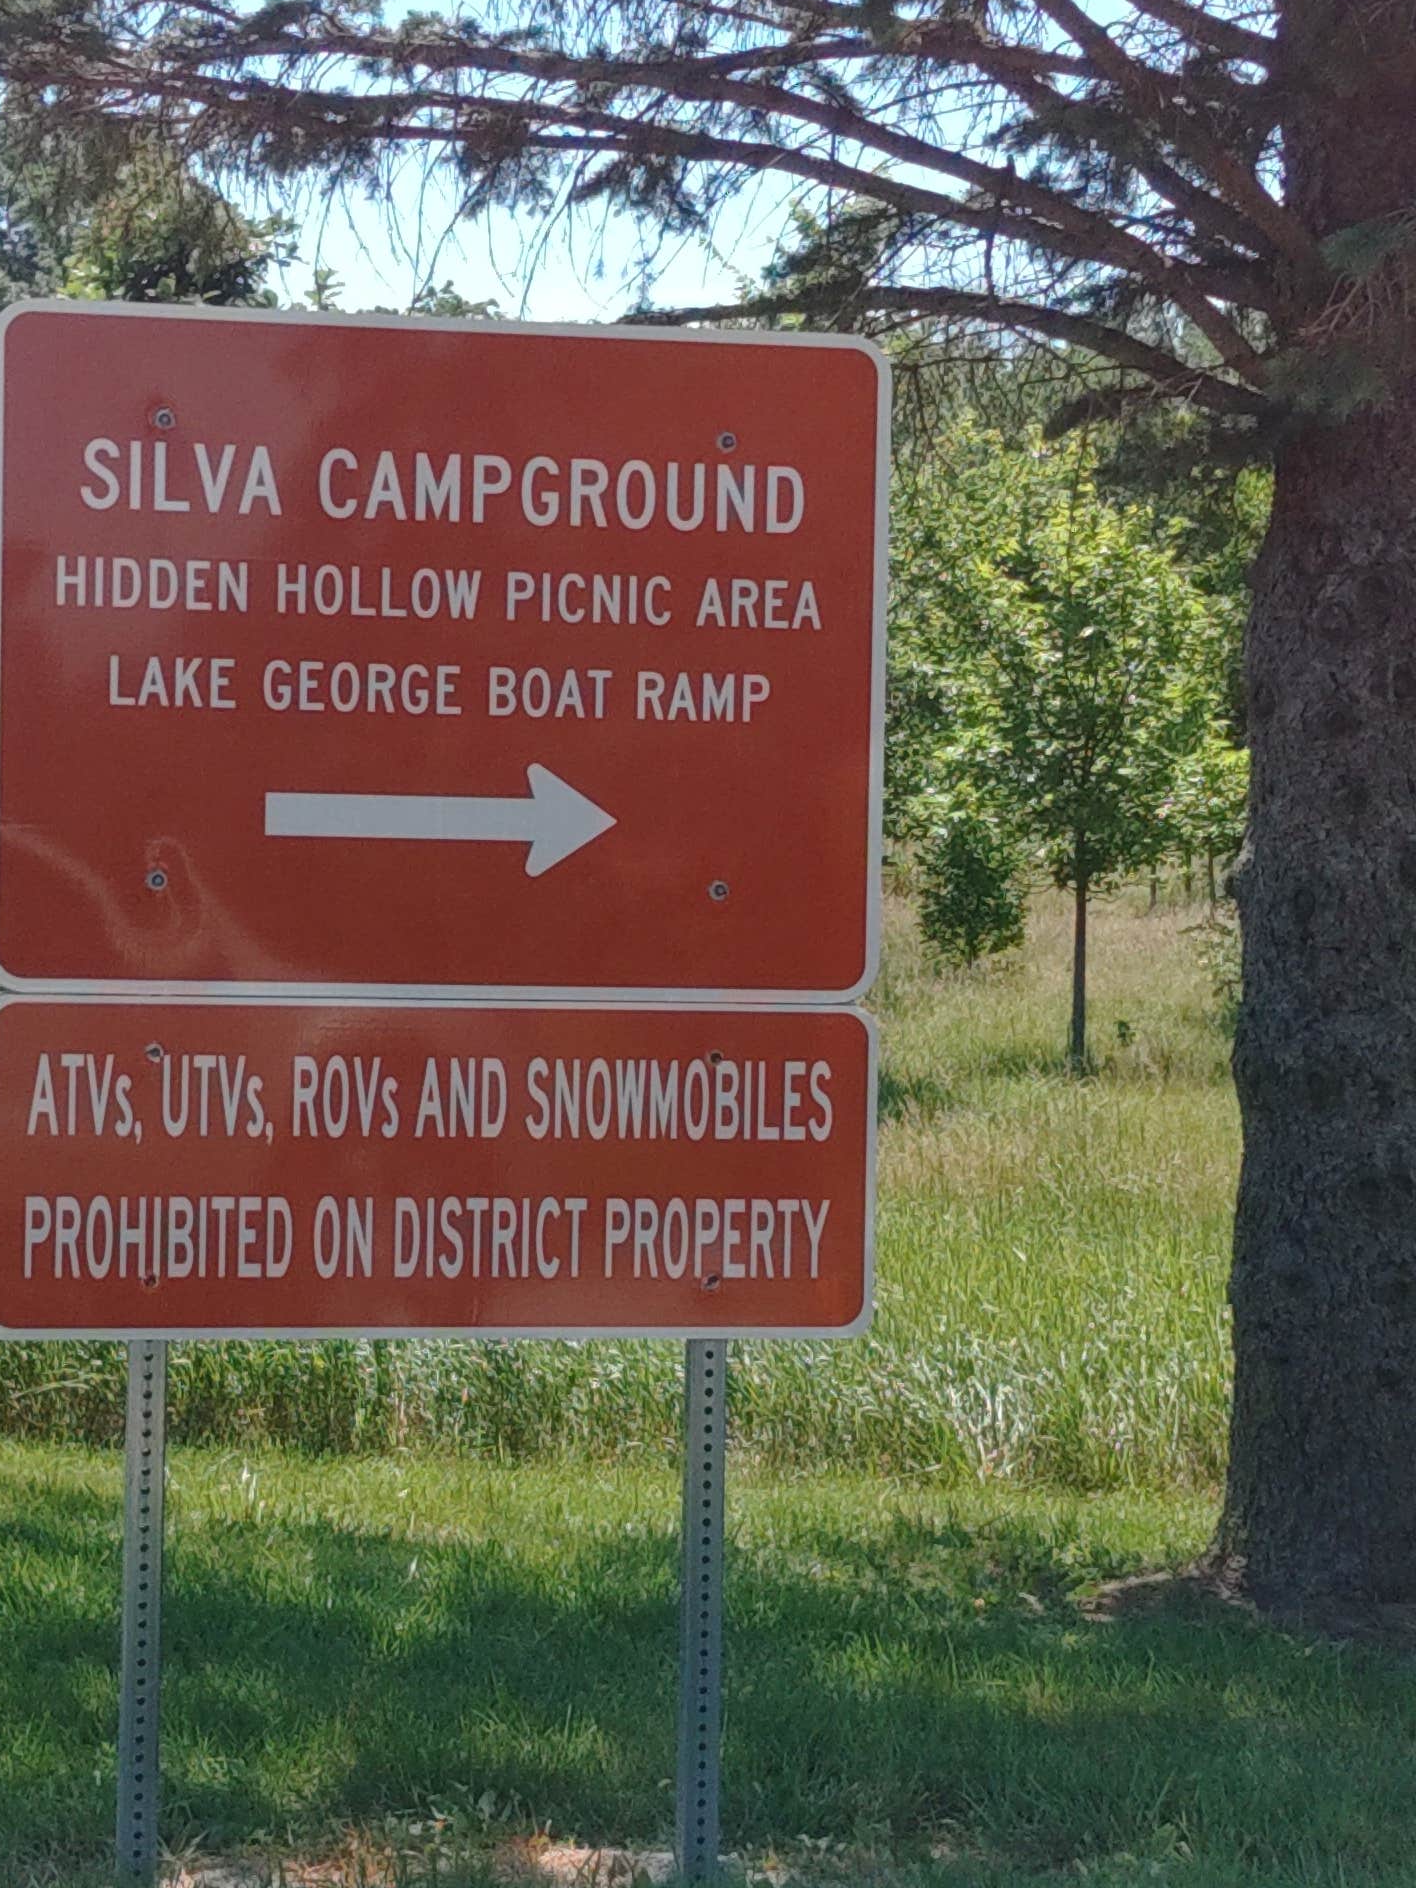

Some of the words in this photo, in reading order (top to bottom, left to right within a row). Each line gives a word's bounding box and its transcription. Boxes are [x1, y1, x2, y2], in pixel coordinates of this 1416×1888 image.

[80, 437, 282, 516] SILVA
[319, 448, 804, 534] CAMPGROUND
[56, 555, 248, 612] HIDDEN
[277, 563, 482, 619] HOLLOW
[507, 571, 671, 626] PICNIC
[696, 578, 821, 630] AREA
[109, 655, 236, 709] LAKE
[263, 660, 462, 715] GEORGE
[489, 667, 613, 719] BOAT
[637, 671, 770, 722] RAMP
[27, 1053, 142, 1144] ATVs,
[162, 1054, 273, 1144] UTVs,
[293, 1055, 399, 1138] ROVs
[414, 1057, 507, 1138] AND
[525, 1057, 833, 1142] SNOWMOBILES
[24, 1195, 293, 1279] PROHIBITED
[313, 1196, 373, 1279] ON
[394, 1196, 587, 1279] DISTRICT
[605, 1197, 830, 1279] PROPERTY
